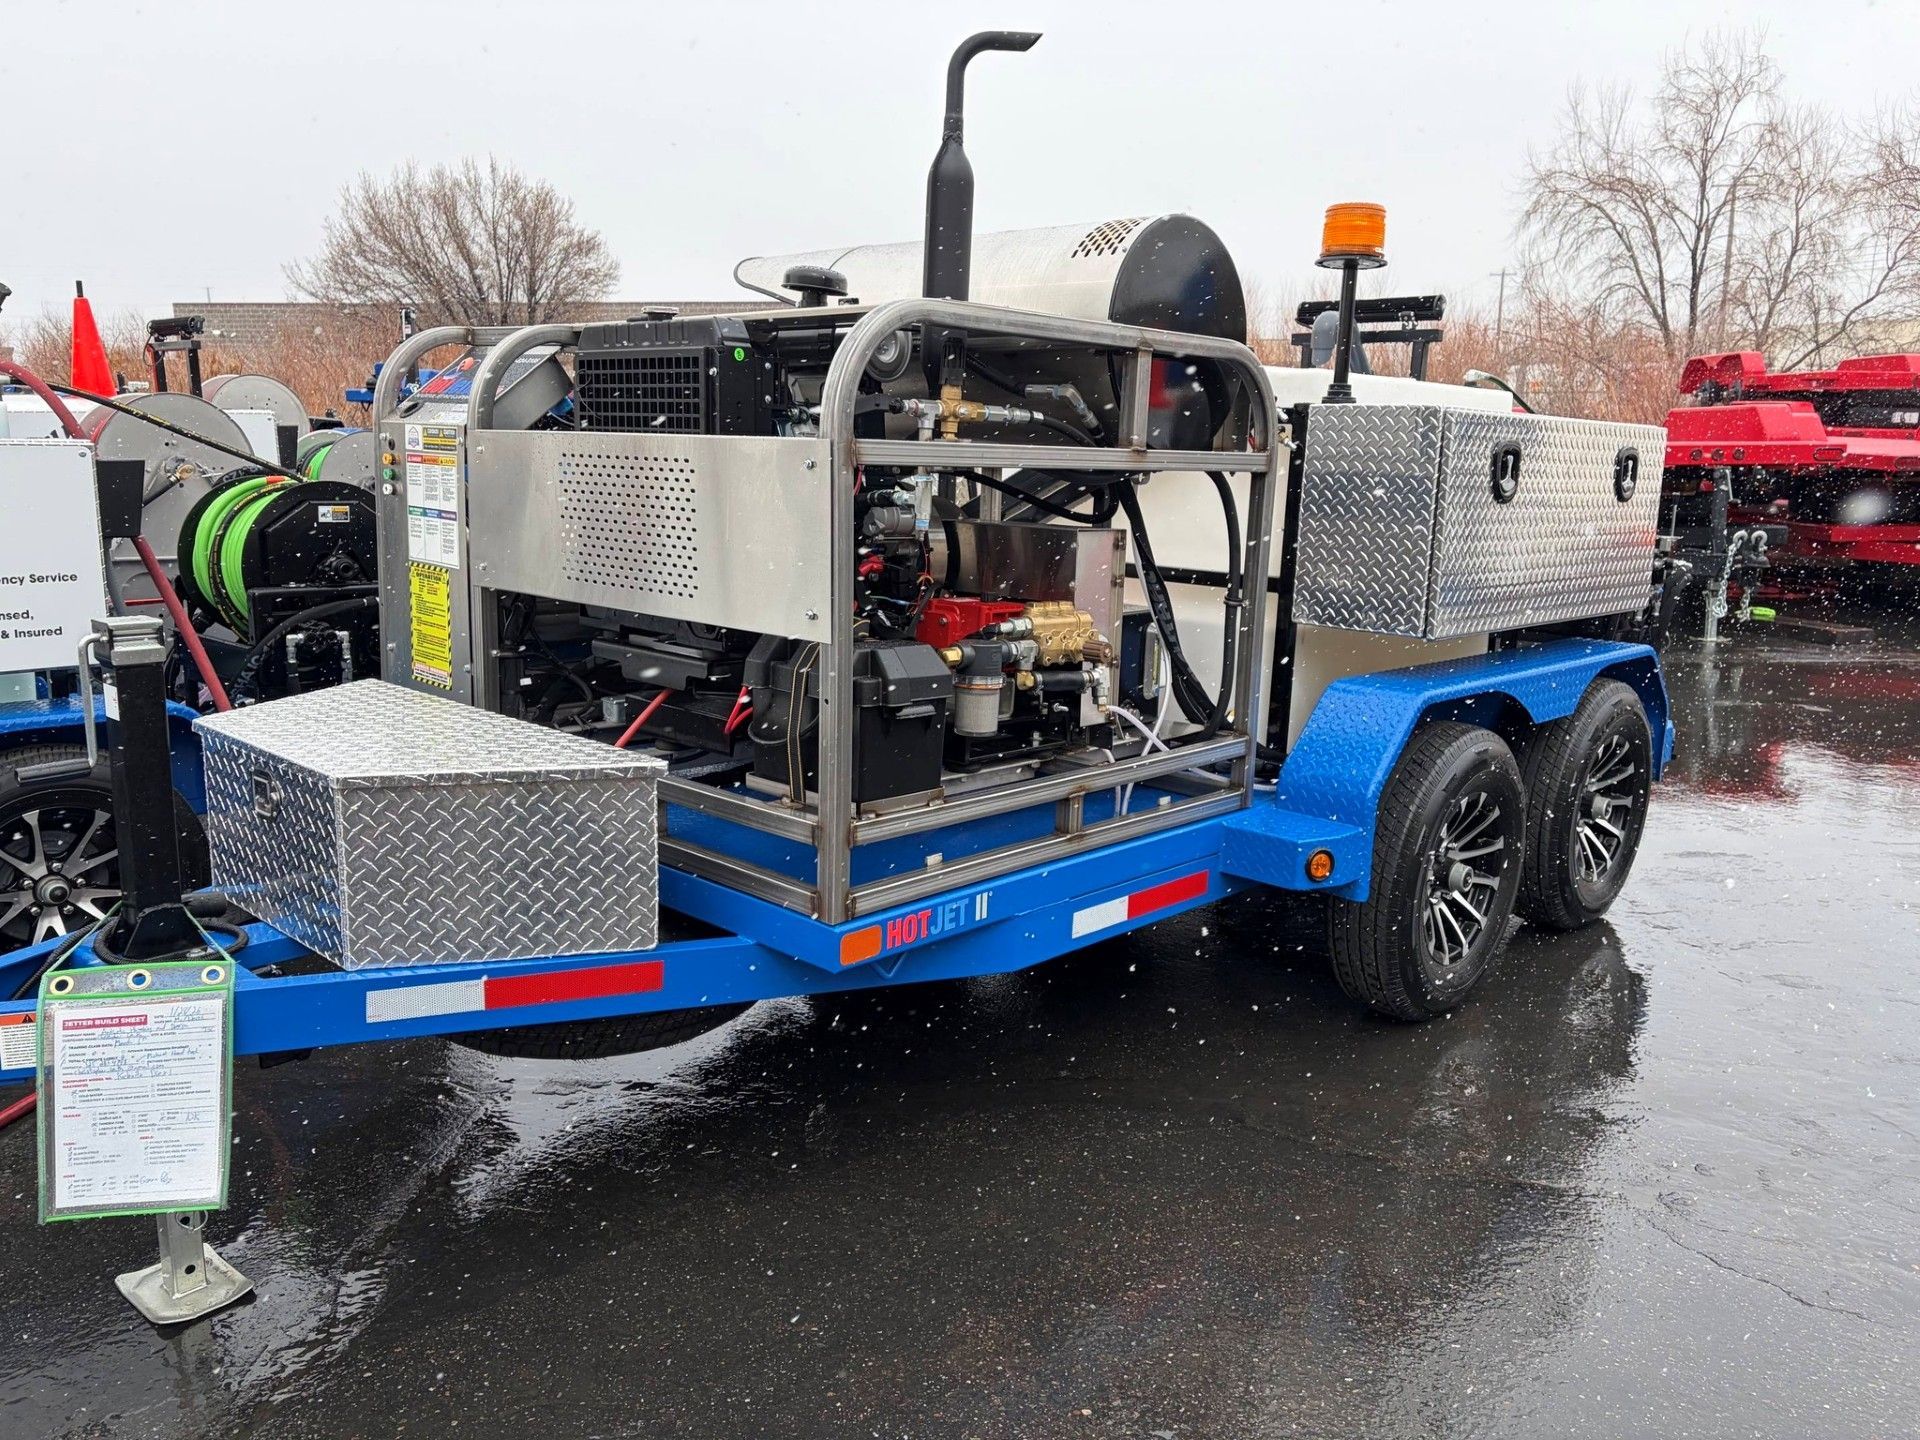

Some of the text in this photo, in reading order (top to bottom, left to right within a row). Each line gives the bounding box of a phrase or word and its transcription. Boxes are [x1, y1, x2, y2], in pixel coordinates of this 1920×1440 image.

[0, 572, 78, 586] ncy Service
[1, 626, 63, 640] & Insured
[63, 1020, 94, 1028] JETTER
[94, 1018, 120, 1026] BUILD
[120, 1016, 147, 1024] SHEET
